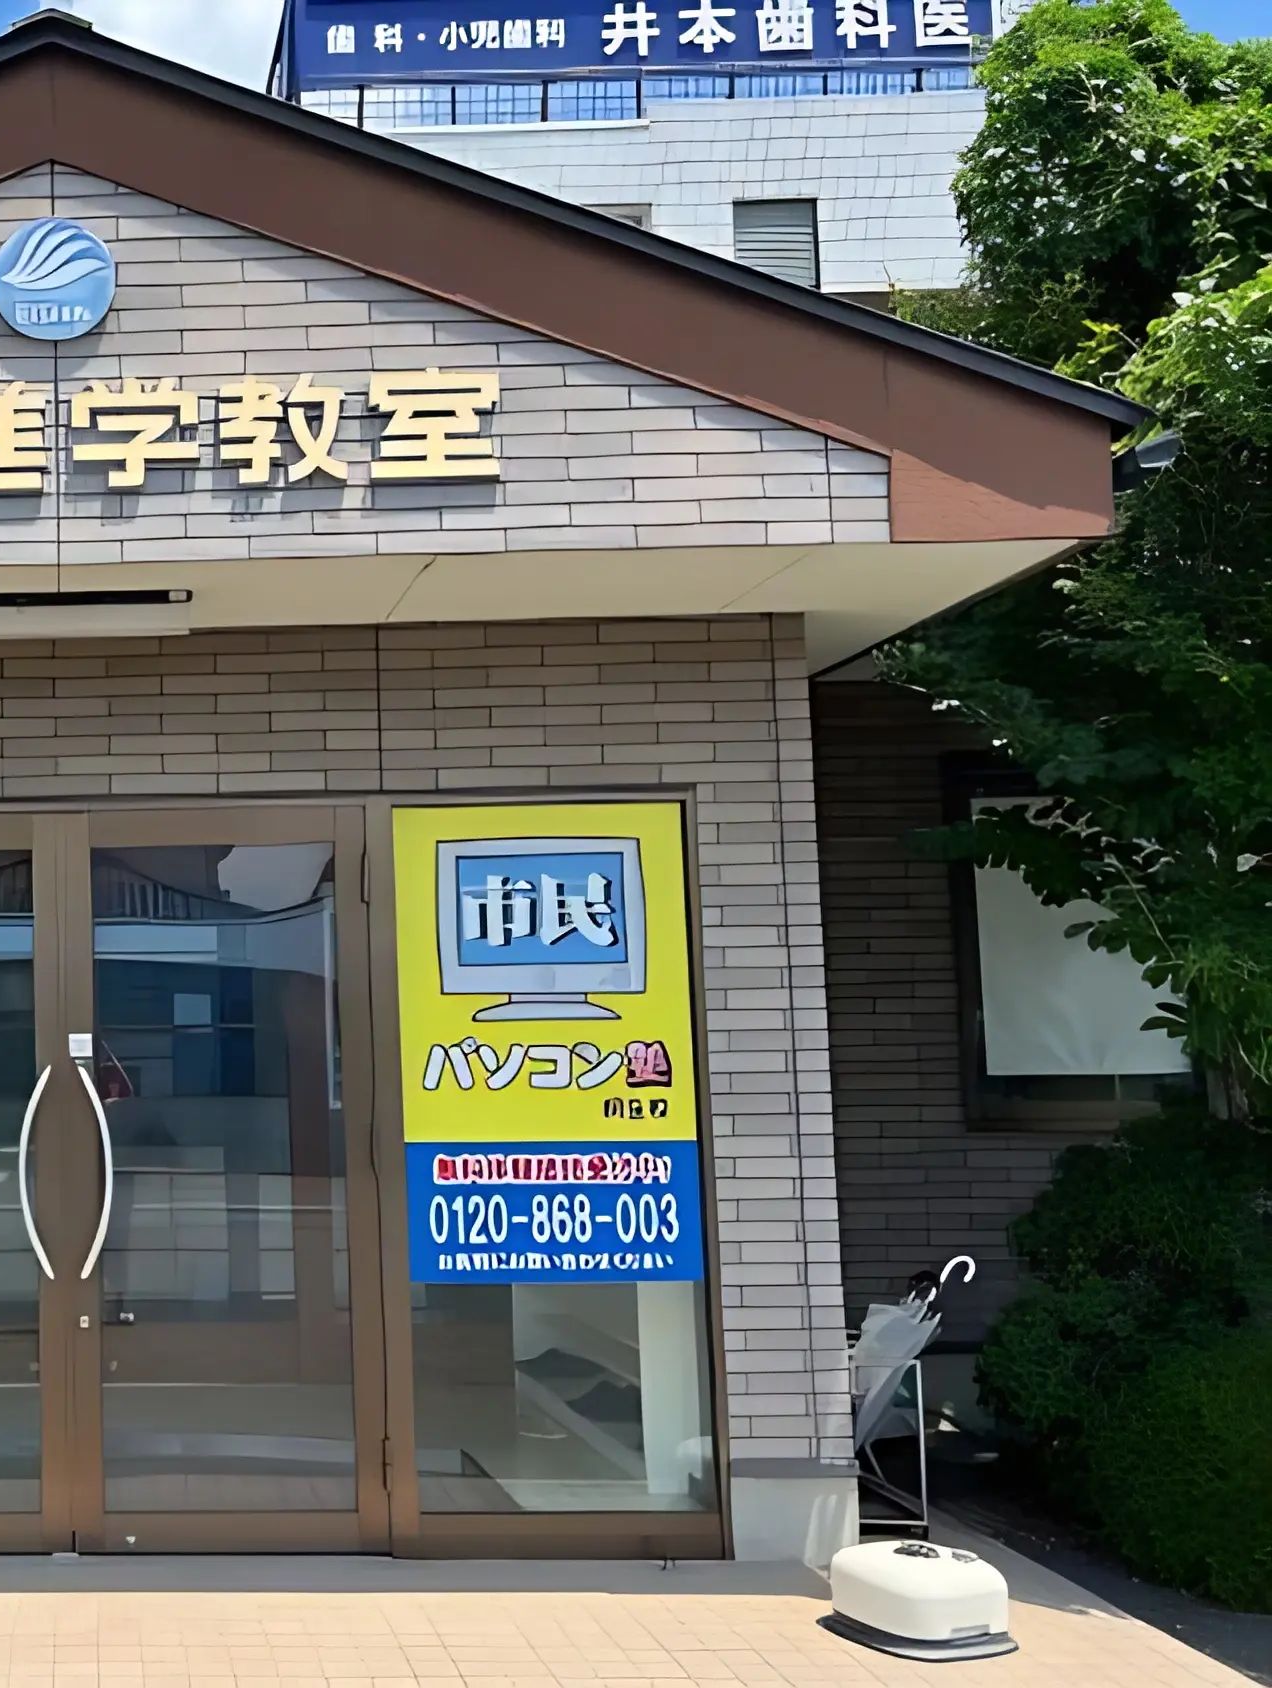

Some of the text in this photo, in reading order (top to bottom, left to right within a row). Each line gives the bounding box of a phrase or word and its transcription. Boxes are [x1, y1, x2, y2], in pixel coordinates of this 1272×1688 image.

[601, 0, 1024, 57] 井本歯科医
[461, 872, 619, 946] 市民
[429, 1193, 679, 1243] 0120-868-003
